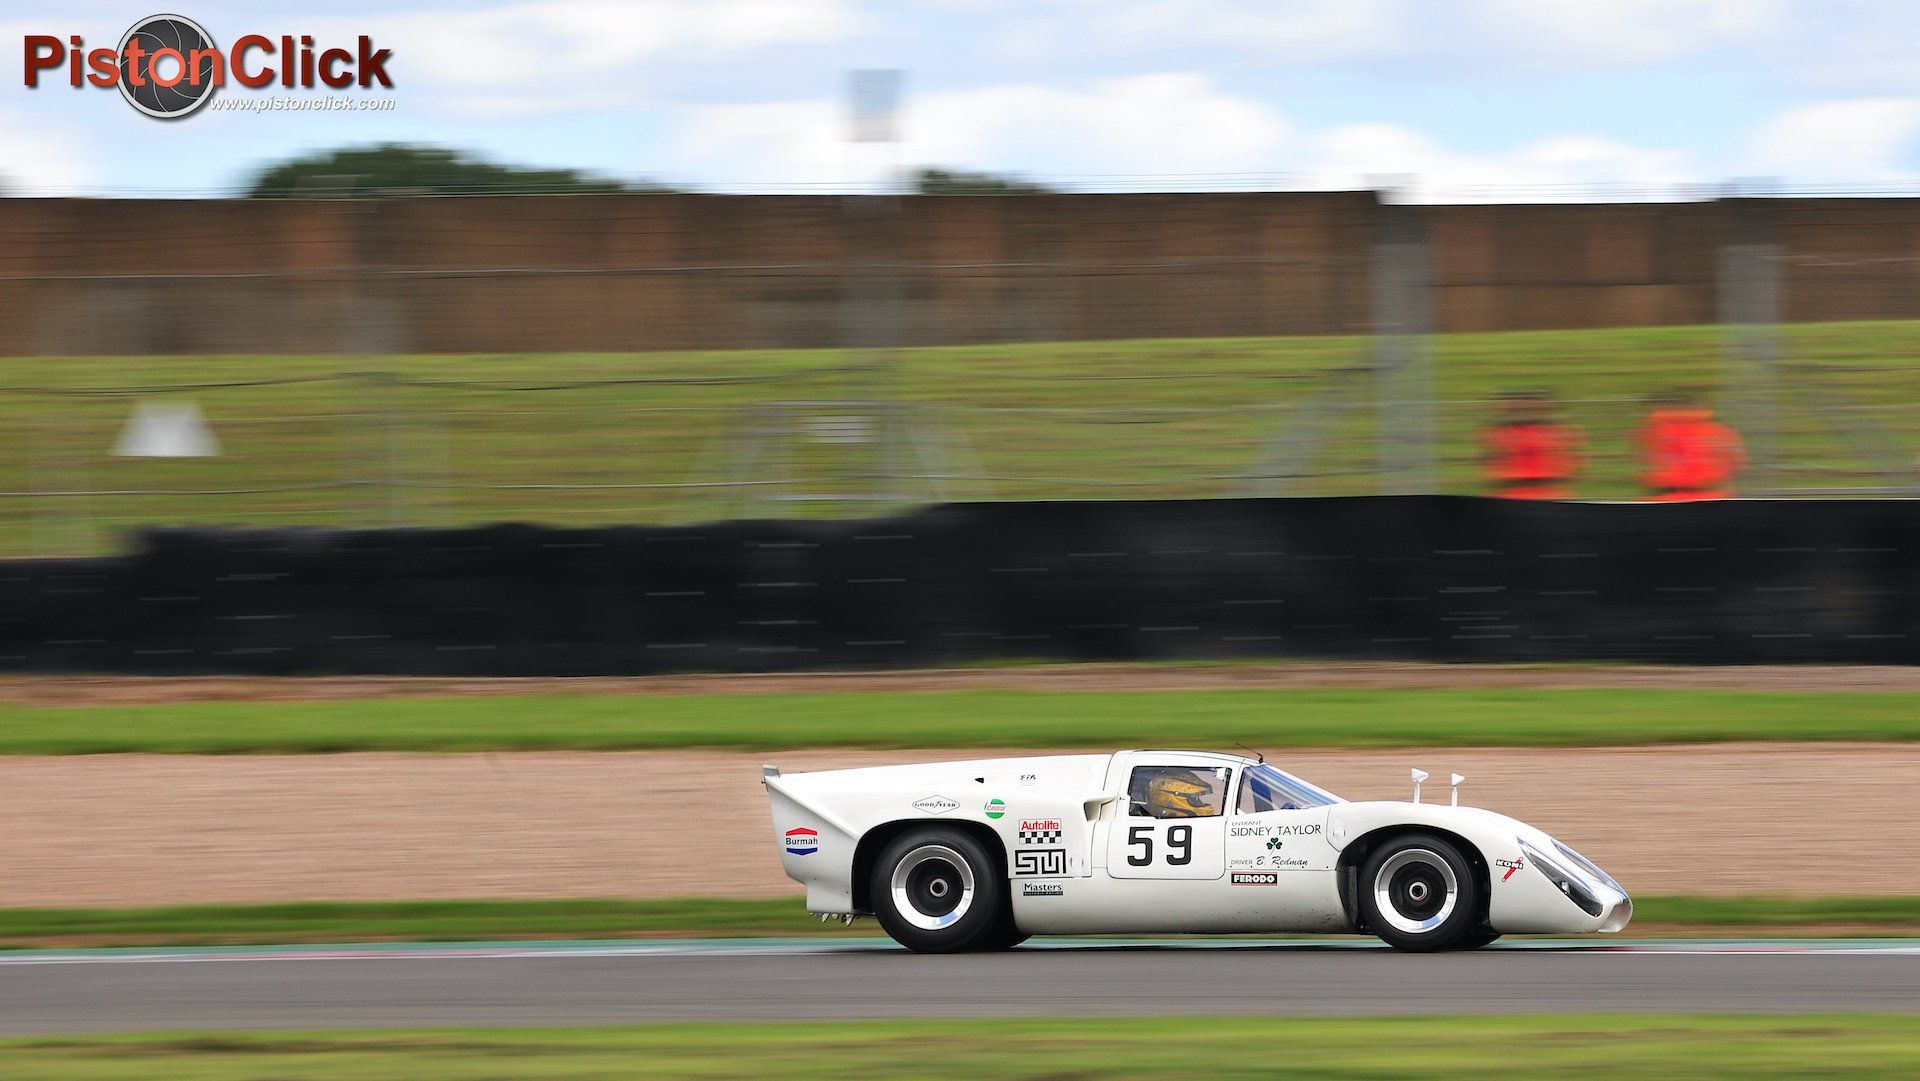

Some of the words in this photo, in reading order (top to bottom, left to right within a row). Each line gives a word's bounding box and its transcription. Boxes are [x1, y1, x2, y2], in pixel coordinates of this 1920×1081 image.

[1021, 821, 1059, 830] Autolite
[1230, 826, 1272, 837] SIDNEY
[1277, 824, 1322, 836] TAYLOR
[785, 837, 818, 845] Burmah
[1127, 825, 1193, 867] 59
[1271, 855, 1308, 866] Redman
[1496, 860, 1523, 869] KONI
[1233, 874, 1276, 884] FERODO
[1024, 883, 1062, 891] Masters
